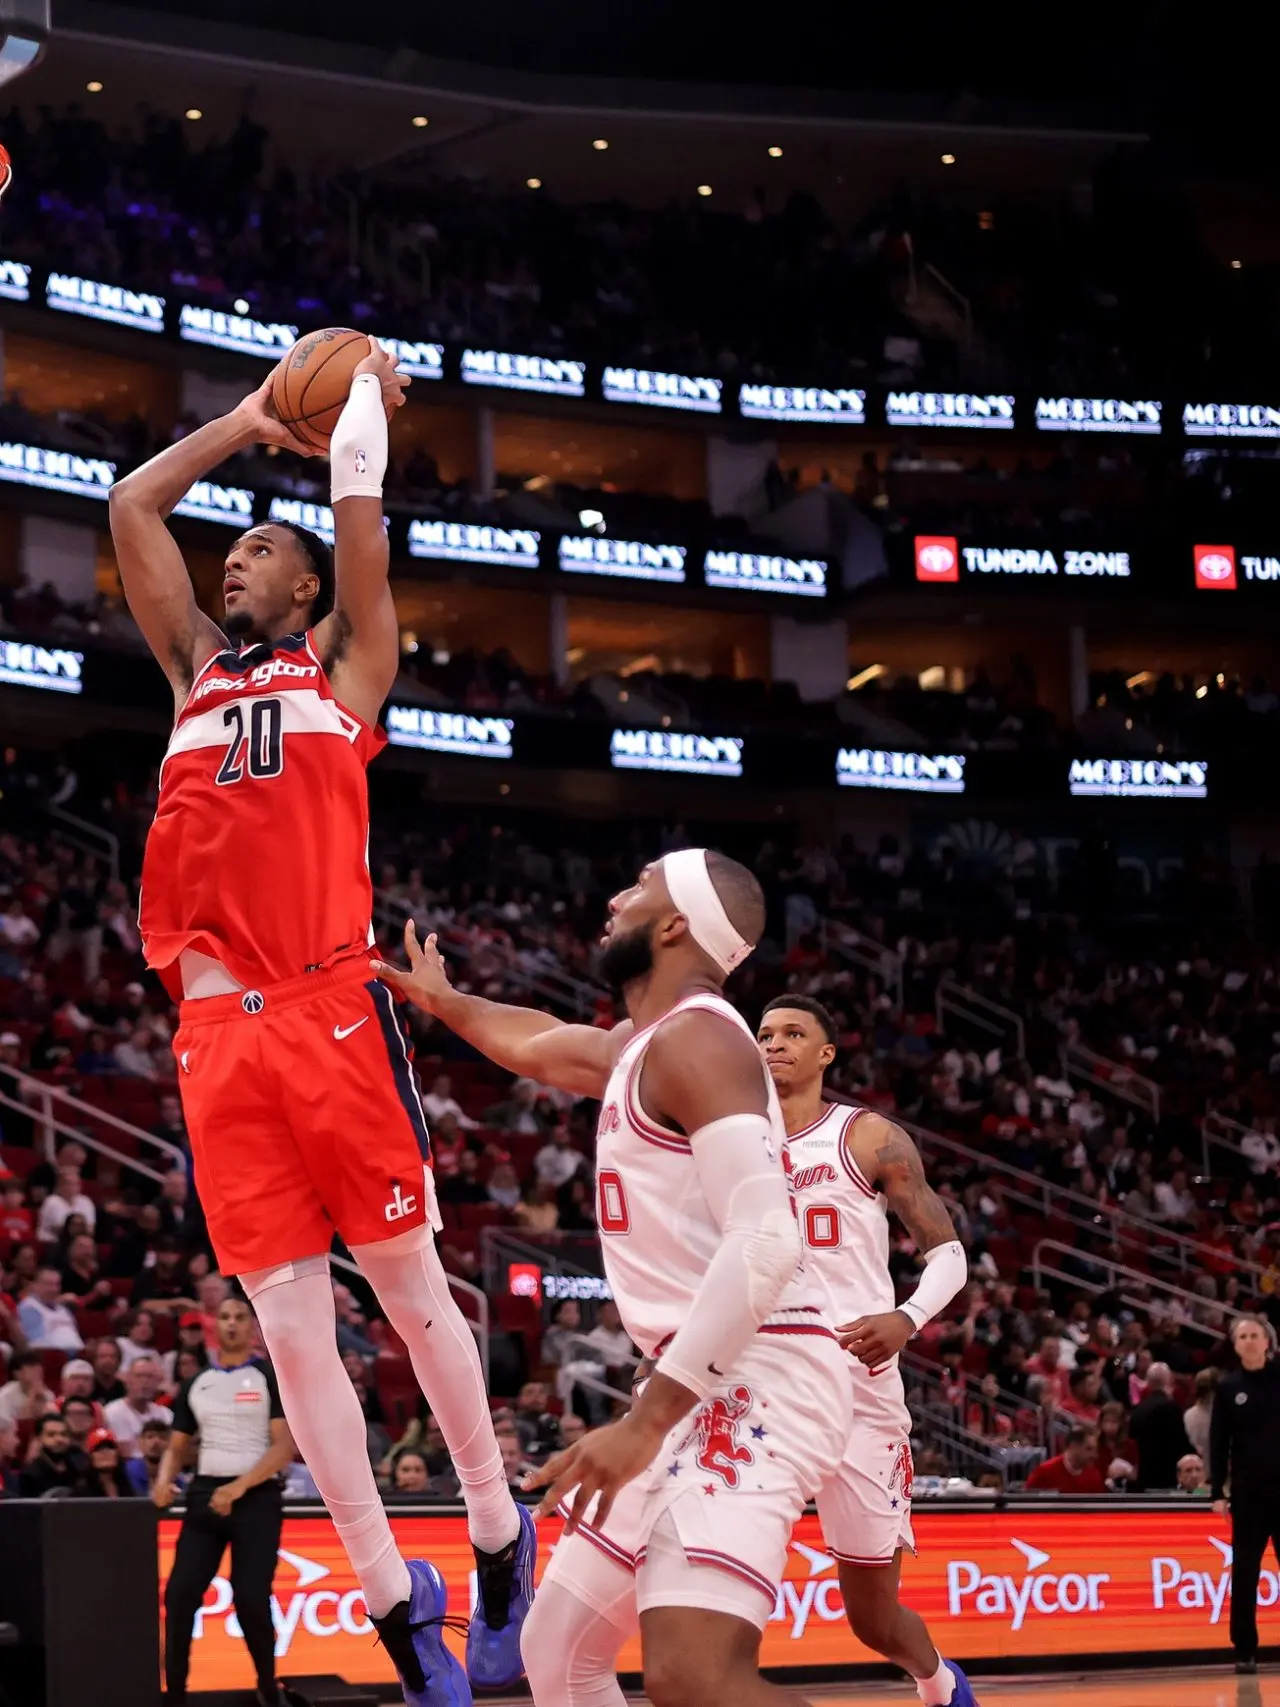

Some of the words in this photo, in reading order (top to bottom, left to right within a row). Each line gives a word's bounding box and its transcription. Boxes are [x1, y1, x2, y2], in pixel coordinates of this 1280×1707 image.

[886, 392, 1015, 419] MORTON'S
[1035, 397, 1162, 424] MORTON'S
[963, 547, 1058, 574] TUNDRA
[1064, 551, 1130, 576] ZONE
[215, 699, 284, 786] 20
[1069, 759, 1208, 785] MORTON'S
[384, 1180, 417, 1222] dc
[947, 1560, 1110, 1630] Paycor
